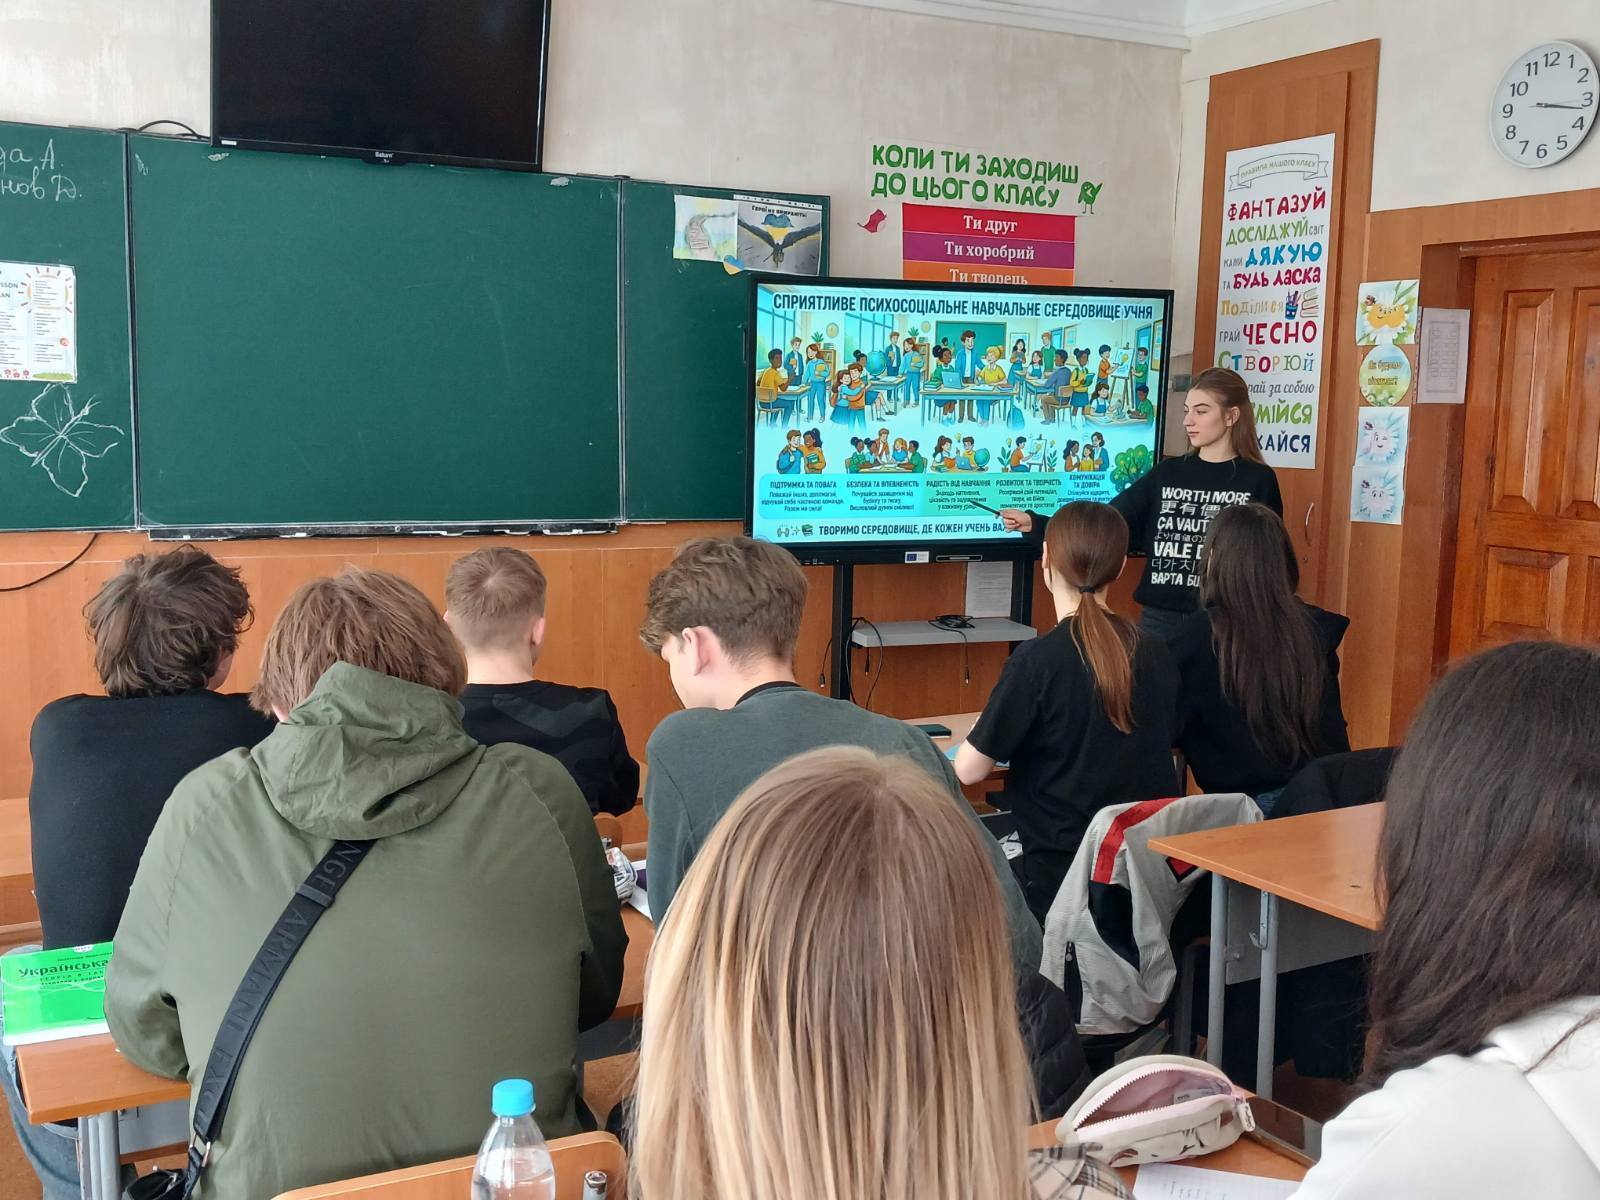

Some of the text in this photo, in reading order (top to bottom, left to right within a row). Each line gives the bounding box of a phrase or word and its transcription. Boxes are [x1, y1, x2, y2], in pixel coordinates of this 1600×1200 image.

[1543, 51, 1560, 68] 12
[1568, 54, 1574, 69] 1
[1525, 61, 1538, 77] 11
[1577, 68, 1589, 83] 2
[1510, 81, 1528, 97] 10
[1581, 92, 1593, 107] 3
[1502, 103, 1513, 118] 9
[1571, 116, 1584, 130] 4
[1505, 125, 1516, 140] 8
[1519, 140, 1529, 155] 7
[1556, 135, 1567, 150] 5
[1536, 144, 1547, 159] 6
[872, 144, 1079, 184] КОЛИ ТИ ЗАХОДИШ
[871, 172, 1060, 208] ДО ЦЬОГО КЛАСУ
[1228, 186, 1326, 221] ФАНТАЗУЙ
[963, 215, 1018, 235] Ти друг
[1226, 216, 1309, 246] ДОСЛІДЖУЙ
[945, 240, 1035, 262] Ти хоробрий
[1245, 241, 1322, 268] ДЯКУЮ
[949, 268, 968, 283] Ти
[1233, 272, 1270, 290] БУДЬ
[773, 294, 1153, 321] СПРИЯТЛИВЕ ПСИХОСОЦІАЛЬНЕ НАВЧАЛЬНЕ СЕРЕДОВИЩЕ УЧНЯ
[1219, 320, 1317, 345] ГРАЙ ЧЕСНО
[1269, 384, 1281, 398] за
[1284, 380, 1315, 394] собою
[770, 481, 805, 489] ПІДТРИМКА
[1161, 487, 1252, 506] WORTH MORE
[819, 525, 860, 536] ТВОРИМО
[862, 524, 920, 535] СЕРЕДОВИЩЕ,
[922, 523, 933, 535] ДЕ
[935, 523, 964, 533] КОЖЕН
[965, 522, 991, 533] УЧЕНЬ
[1176, 517, 1210, 533] VAUT
[1153, 541, 1193, 559] VALE
[1151, 572, 1183, 586] ВАРТА
[19, 959, 109, 978] Українська
